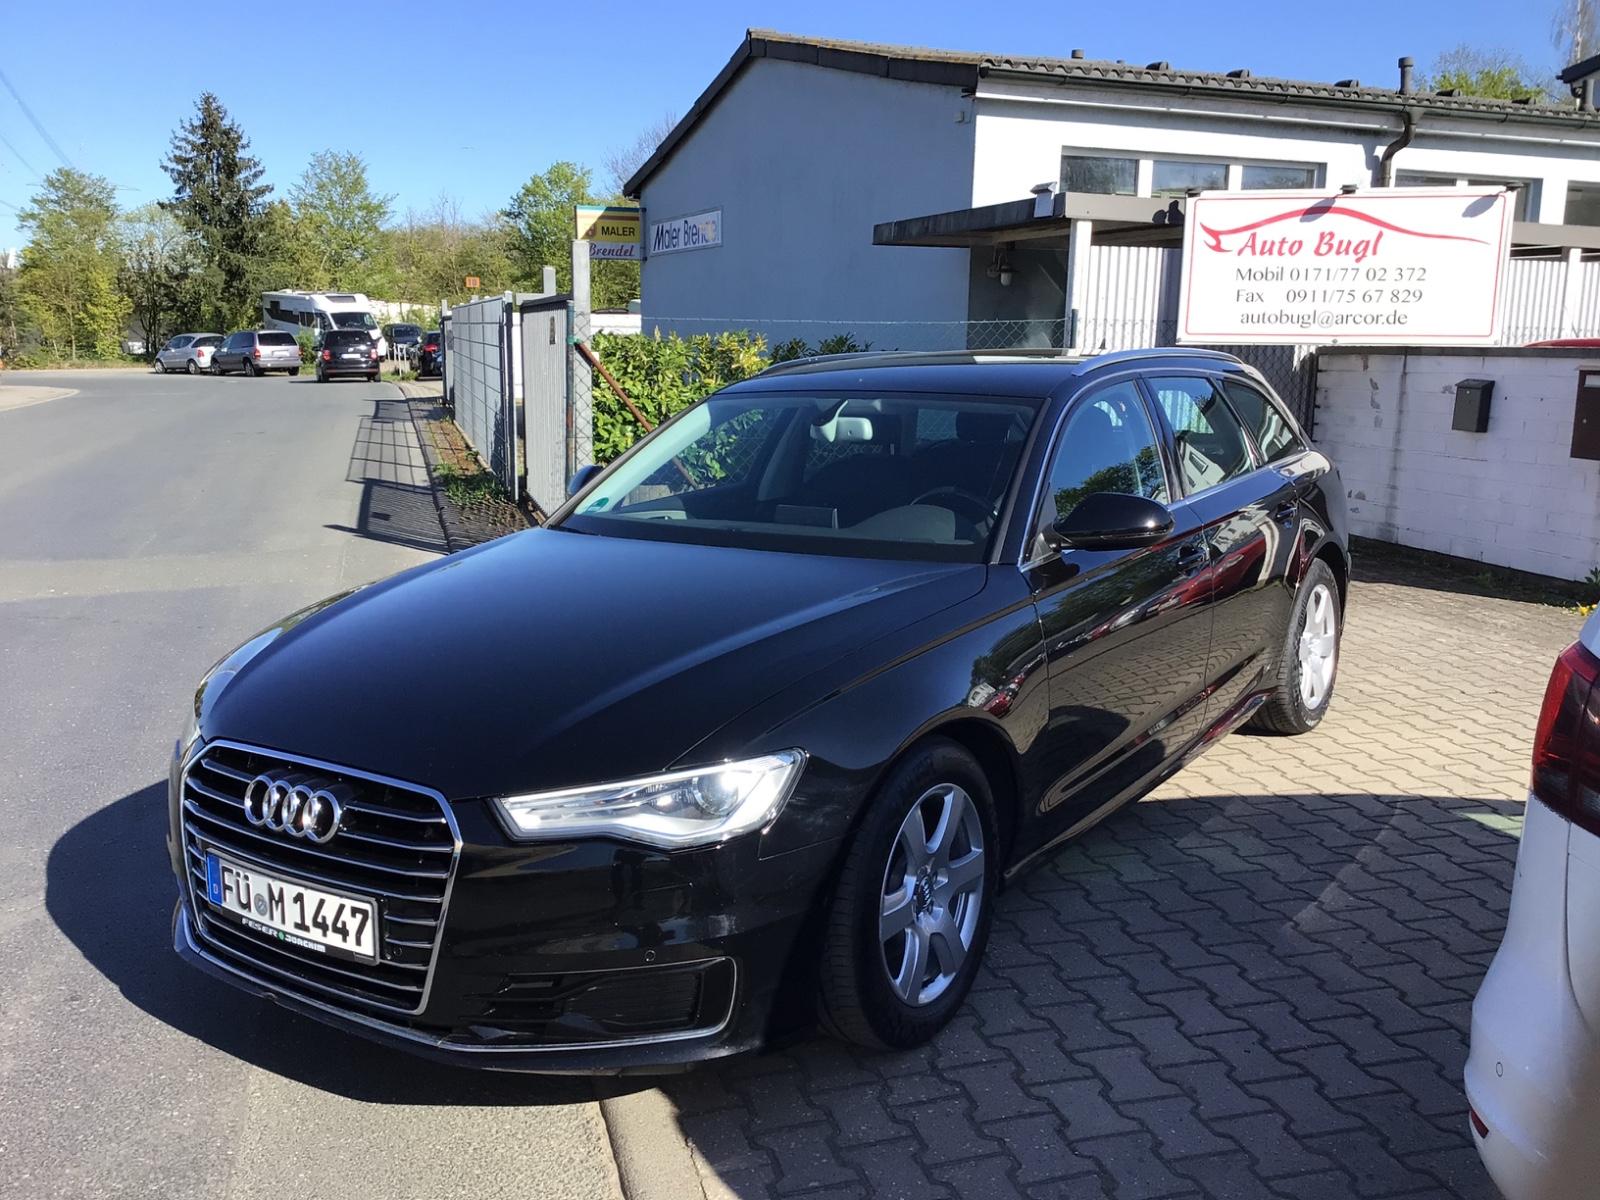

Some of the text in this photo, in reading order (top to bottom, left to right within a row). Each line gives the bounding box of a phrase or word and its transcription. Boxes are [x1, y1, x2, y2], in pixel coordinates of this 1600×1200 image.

[601, 226, 636, 237] MALER
[653, 222, 680, 251] Maler
[589, 242, 635, 257] Brendel
[1237, 230, 1384, 263] Auto Bugl
[1235, 266, 1427, 282] Mobil 0171/77 02 372
[1236, 288, 1424, 304] Fax 0911/75 67 829
[1240, 309, 1408, 329] autobugl@arcor.de
